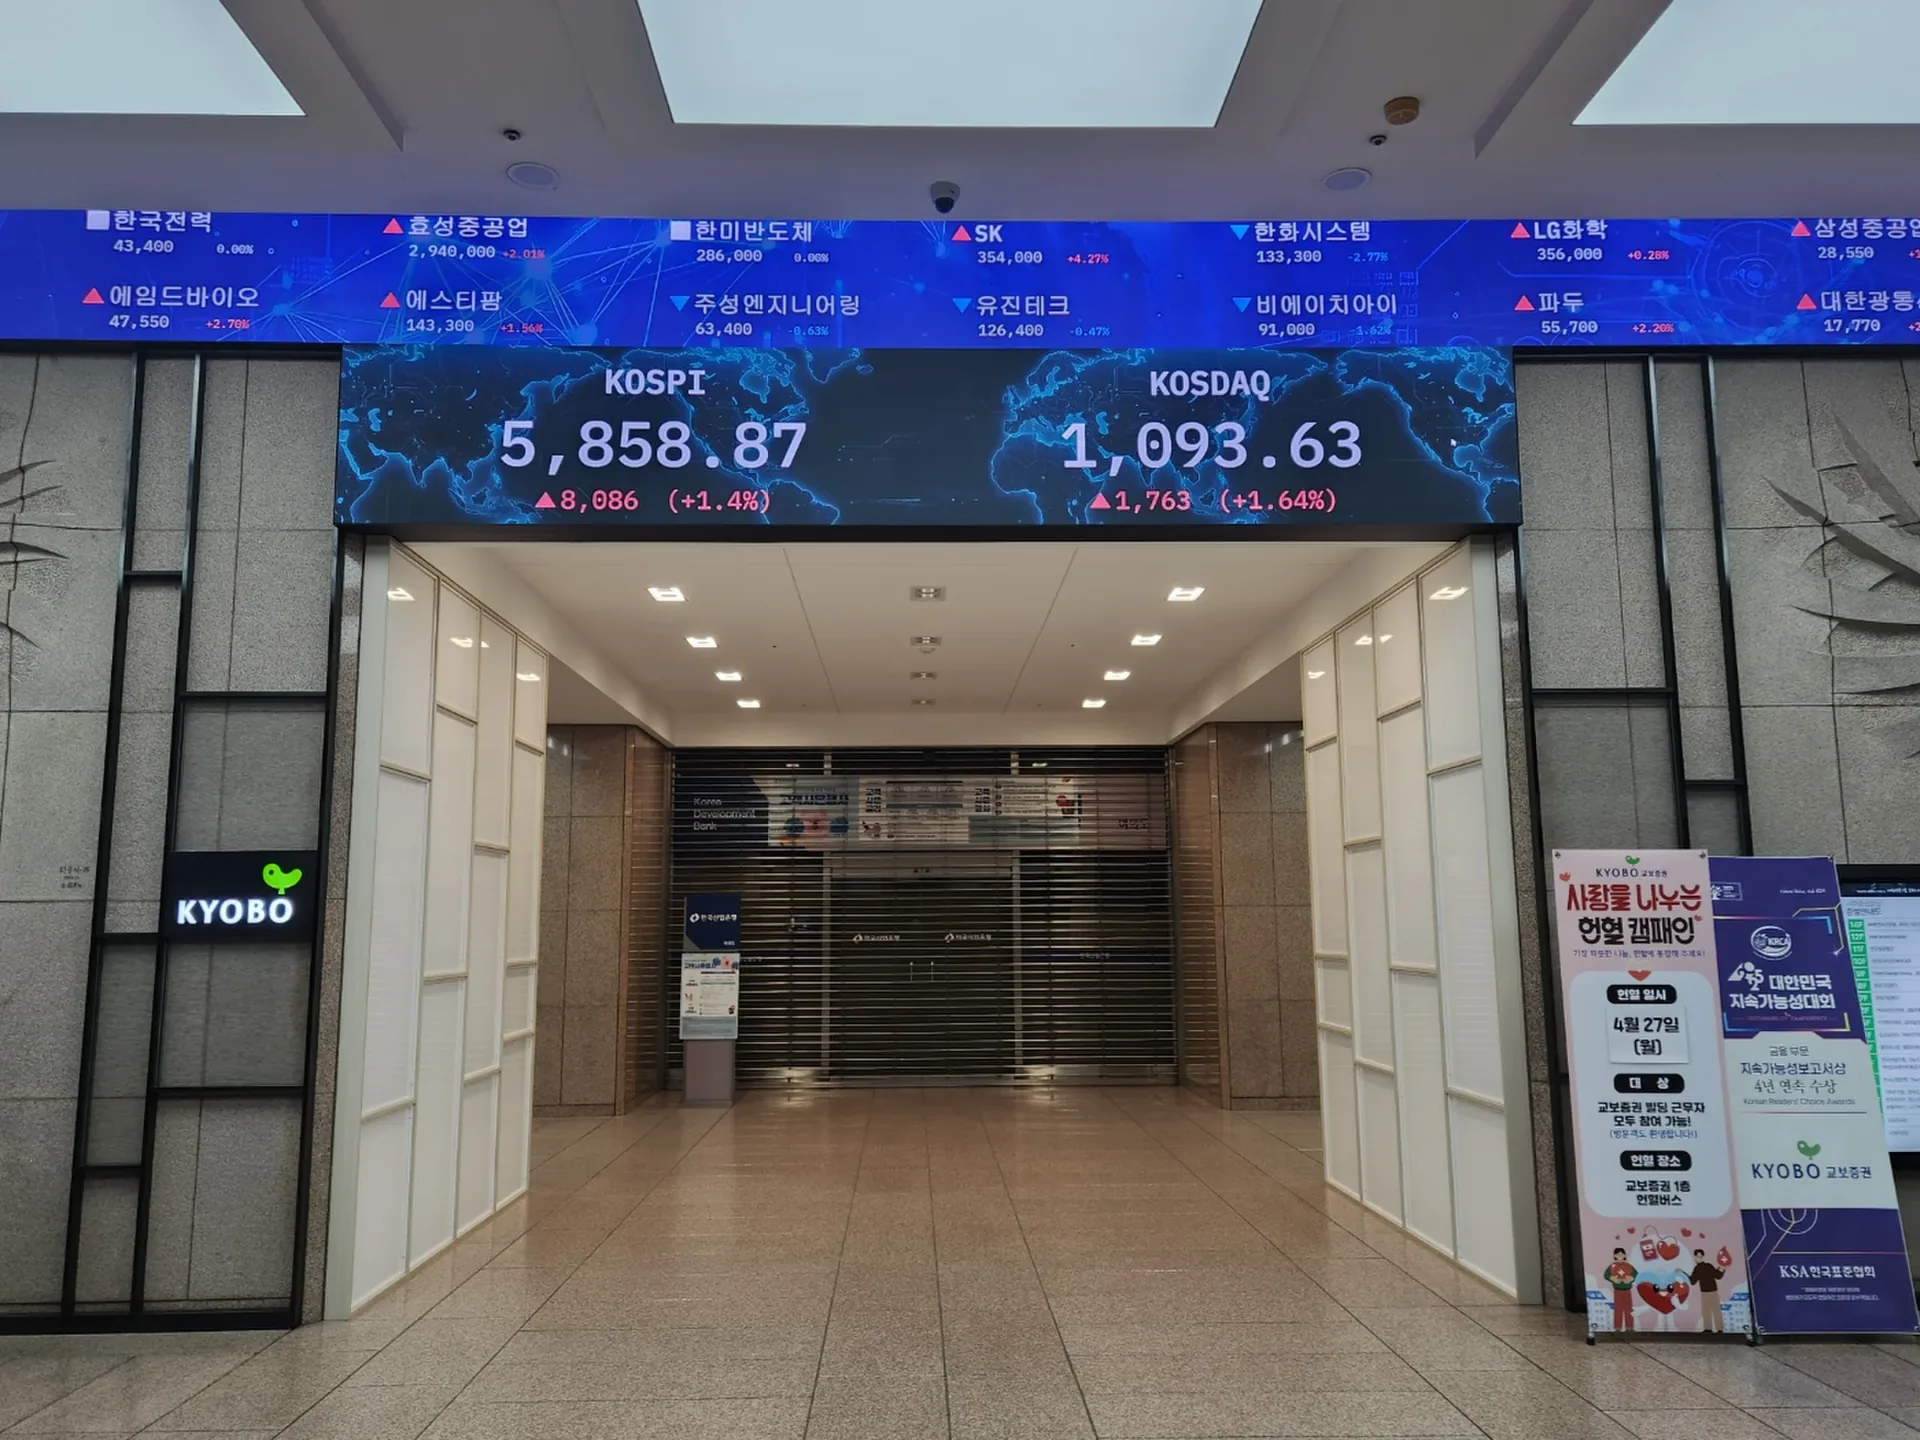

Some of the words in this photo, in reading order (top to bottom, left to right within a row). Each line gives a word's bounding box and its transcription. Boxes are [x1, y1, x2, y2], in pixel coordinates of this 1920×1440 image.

[408, 216, 528, 238] 효성중공업
[695, 220, 812, 242] 한미반도체
[975, 224, 1003, 242] SK
[1254, 221, 1370, 242] 한화시스템
[1534, 219, 1608, 240] LG화학
[113, 240, 174, 254] 43,400
[216, 244, 254, 254] 0.00%
[408, 244, 496, 260] 2,940,000
[502, 249, 545, 259] +2.01%
[1536, 248, 1602, 262] 356,000
[1627, 250, 1670, 260] +0.28%
[1818, 246, 1874, 260] 28,550
[696, 249, 763, 264] 286,000
[794, 253, 829, 263] 0.00%
[977, 251, 1043, 266] 354,000
[1067, 254, 1109, 264] +4.27%
[1256, 250, 1322, 265] 133,300
[1348, 252, 1389, 262] -2.77%
[109, 285, 259, 308] 에임드바이오
[406, 289, 502, 312] 에스티팜
[694, 293, 860, 316] 주성엔지니어링
[1538, 292, 1584, 313] 파두
[1820, 290, 1920, 312] 대한광통
[976, 295, 1070, 316] 유진테크
[1256, 294, 1397, 316] 비에이치아이
[109, 315, 169, 330] 47,550
[206, 319, 250, 329] +2.70%
[406, 319, 474, 333] 143,300
[695, 322, 752, 337] 63,400
[788, 326, 829, 336] -0.63%
[1258, 323, 1315, 338] 91,000
[1541, 320, 1598, 335] 55,700
[1632, 324, 1675, 333] +2.20%
[1823, 319, 1881, 334] 17,770
[978, 324, 1044, 338] 126,400
[1070, 326, 1110, 336] -0.47%
[604, 368, 706, 395] KOSPI
[1150, 370, 1271, 402] KOSDAQ
[500, 420, 807, 477] 5,858.87
[1061, 420, 1363, 477] 1,093.63
[560, 489, 640, 513] 8,086
[668, 488, 771, 514] (+1.4%)
[1115, 490, 1192, 514] 1,763
[1220, 488, 1336, 514] (+1.64%)
[693, 809, 756, 820] Development
[693, 821, 717, 831] Bank
[1596, 868, 1638, 878] KYOBO
[1566, 884, 1631, 912] 사랑을
[1636, 884, 1702, 912] 나누는
[177, 898, 293, 925] KYOBO
[1578, 916, 1625, 945] 헌혈
[1769, 974, 1832, 991] 대한민국
[1617, 988, 1641, 1001] 헌혈
[1643, 988, 1667, 1001] 일시
[1729, 993, 1836, 1010] 지속가능성대회
[1613, 1017, 1640, 1033] 4월
[1643, 1017, 1680, 1033] 27일
[1634, 1038, 1662, 1056] (월)
[1740, 1062, 1846, 1075] 지속가능성보고서상
[1754, 1079, 1776, 1094] 4년
[1779, 1079, 1806, 1094] 연속
[1809, 1079, 1838, 1094] 수상
[1597, 1101, 1642, 1113] 교보증권
[1645, 1101, 1668, 1113] 빌딩
[1671, 1101, 1705, 1113] 근무자
[1613, 1116, 1636, 1127] 모두
[1639, 1115, 1662, 1127] 참여
[1665, 1115, 1692, 1127] 가능!
[1630, 1154, 1654, 1167] 헌혈
[1657, 1154, 1681, 1167] 장소
[1751, 1163, 1820, 1179] KYOBO
[1825, 1166, 1872, 1179] 교보증권
[1625, 1180, 1671, 1192] 교보증권
[1673, 1180, 1691, 1192] 1층
[1636, 1194, 1683, 1206] 헌혈버스
